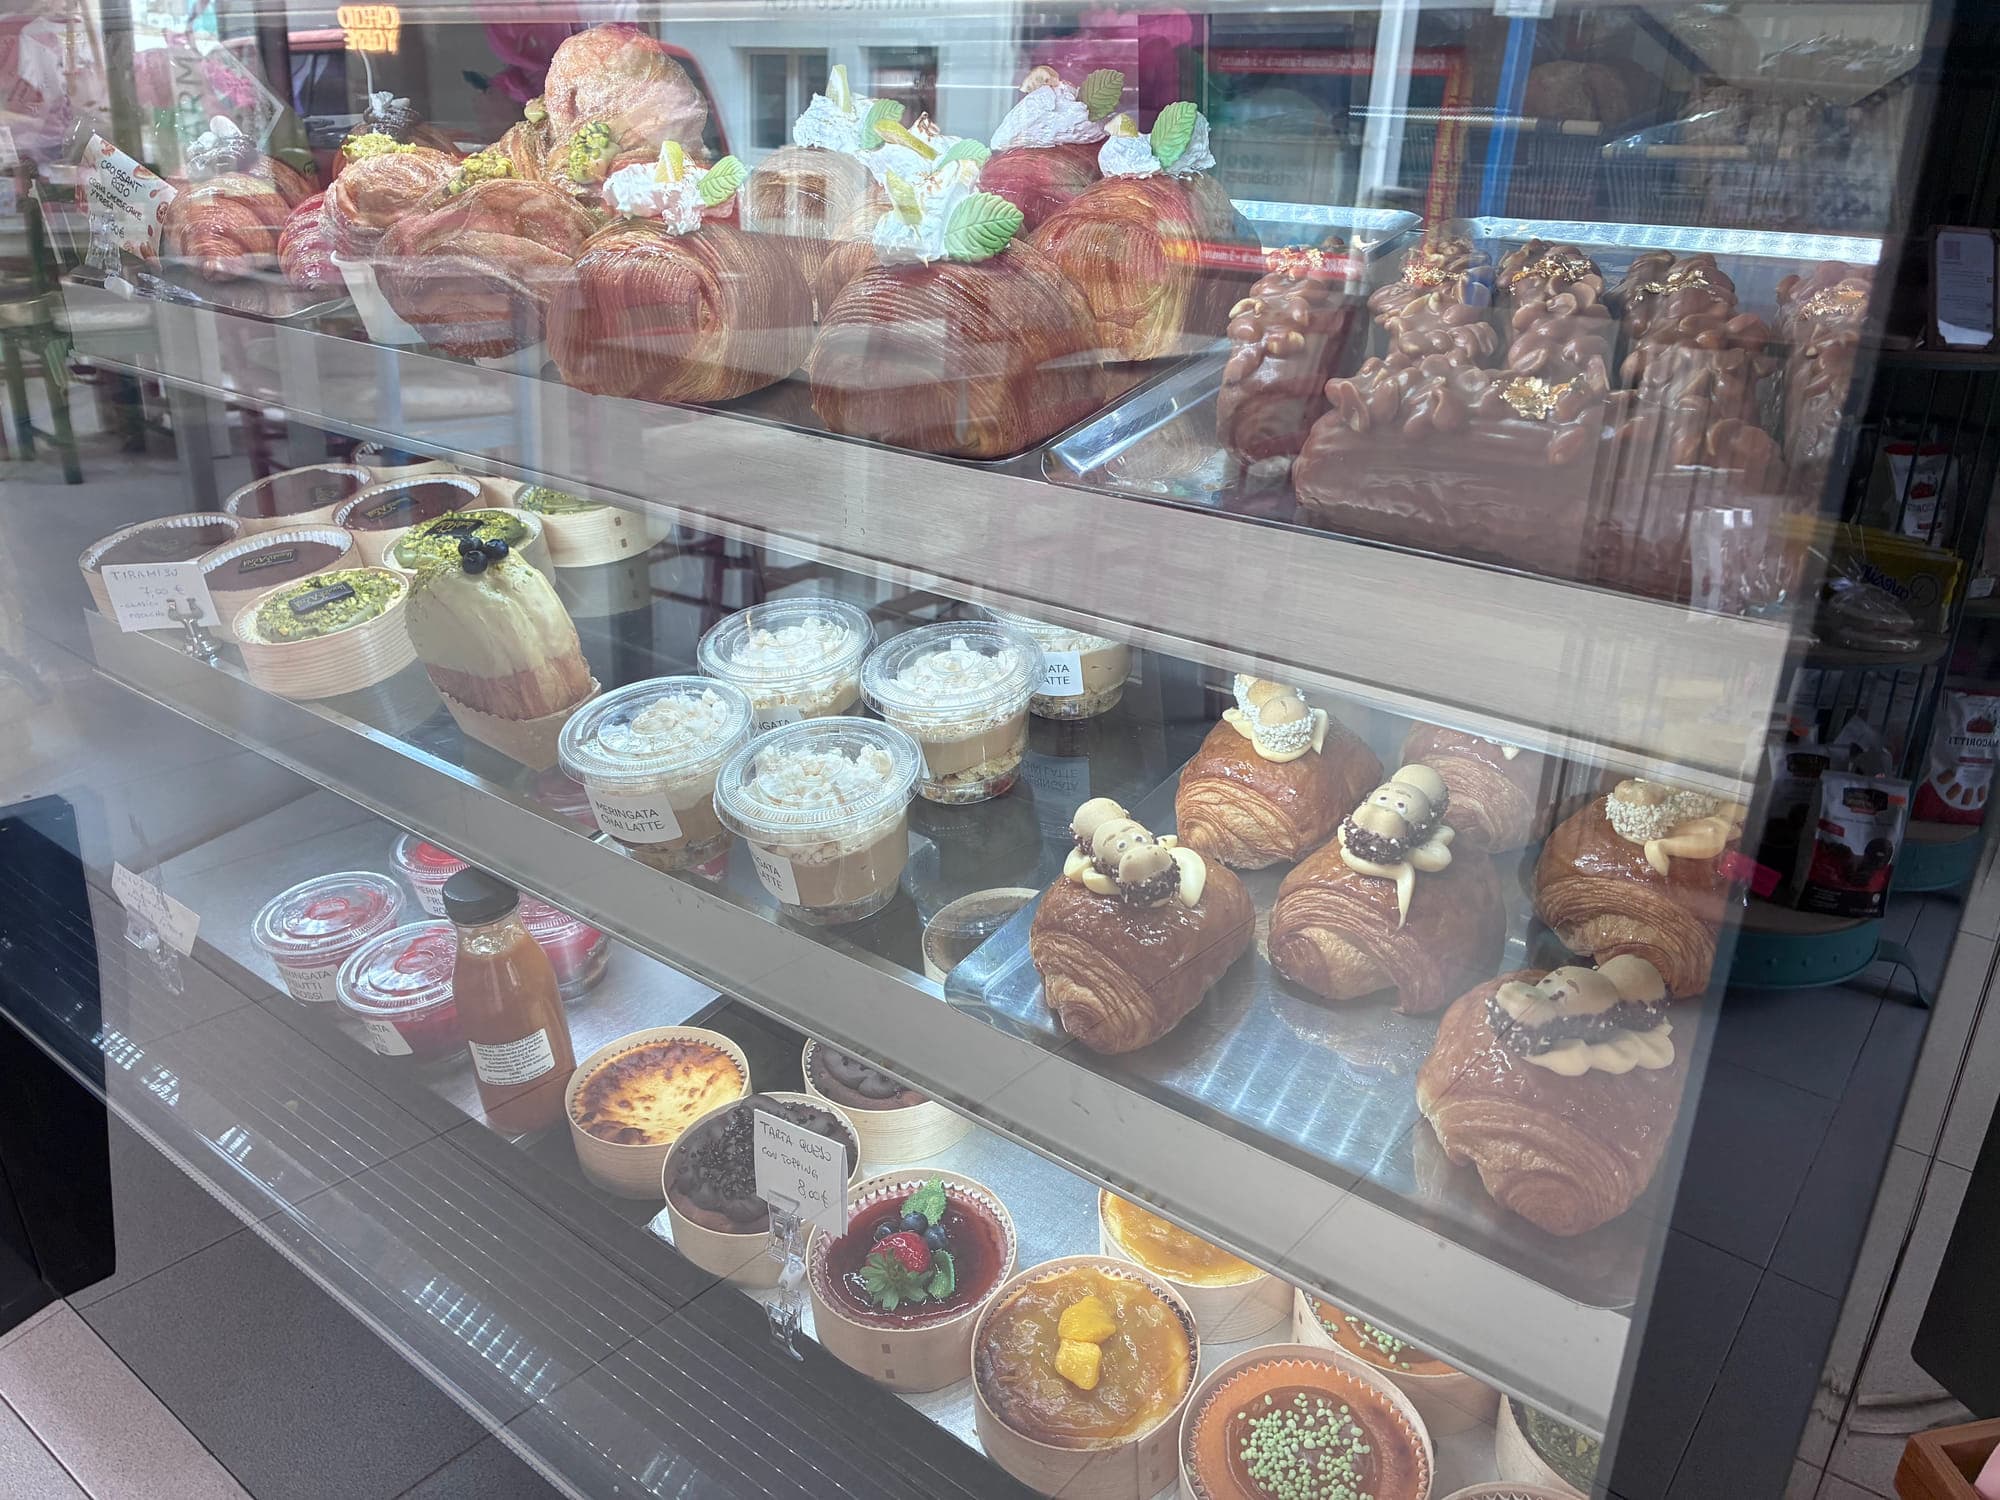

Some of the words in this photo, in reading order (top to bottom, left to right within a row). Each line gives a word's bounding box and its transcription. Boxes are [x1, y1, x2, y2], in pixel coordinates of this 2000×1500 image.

[101, 160, 142, 193] CROISSANT
[111, 568, 178, 581] TIRAMISU
[595, 800, 660, 820] MERINGATA
[624, 820, 666, 833] LATTE
[760, 1120, 793, 1147] TARTA
[761, 1146, 778, 1160] CON
